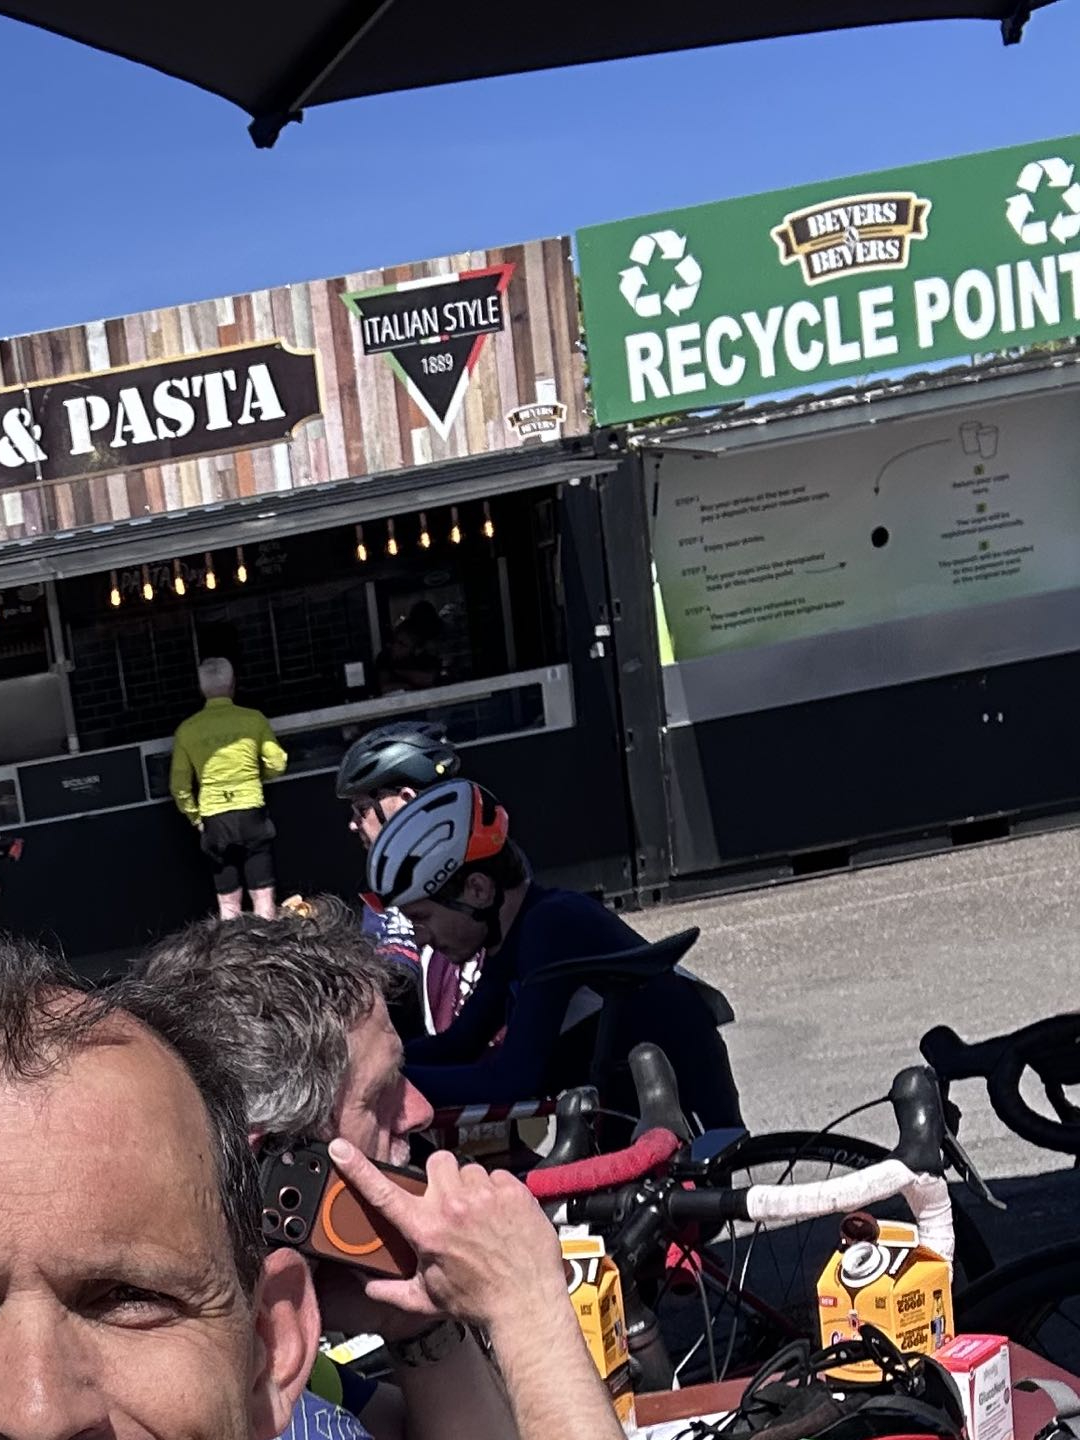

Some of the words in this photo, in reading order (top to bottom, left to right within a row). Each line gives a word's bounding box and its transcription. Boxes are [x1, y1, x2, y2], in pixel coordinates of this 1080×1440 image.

[807, 201, 898, 238] BEVERS
[810, 237, 901, 275] BEVERS
[362, 307, 438, 344] ITALIAN
[444, 294, 502, 332] STYLE
[420, 352, 455, 376] 1889
[625, 285, 899, 403] RECYCLE
[60, 362, 289, 457] PASTA
